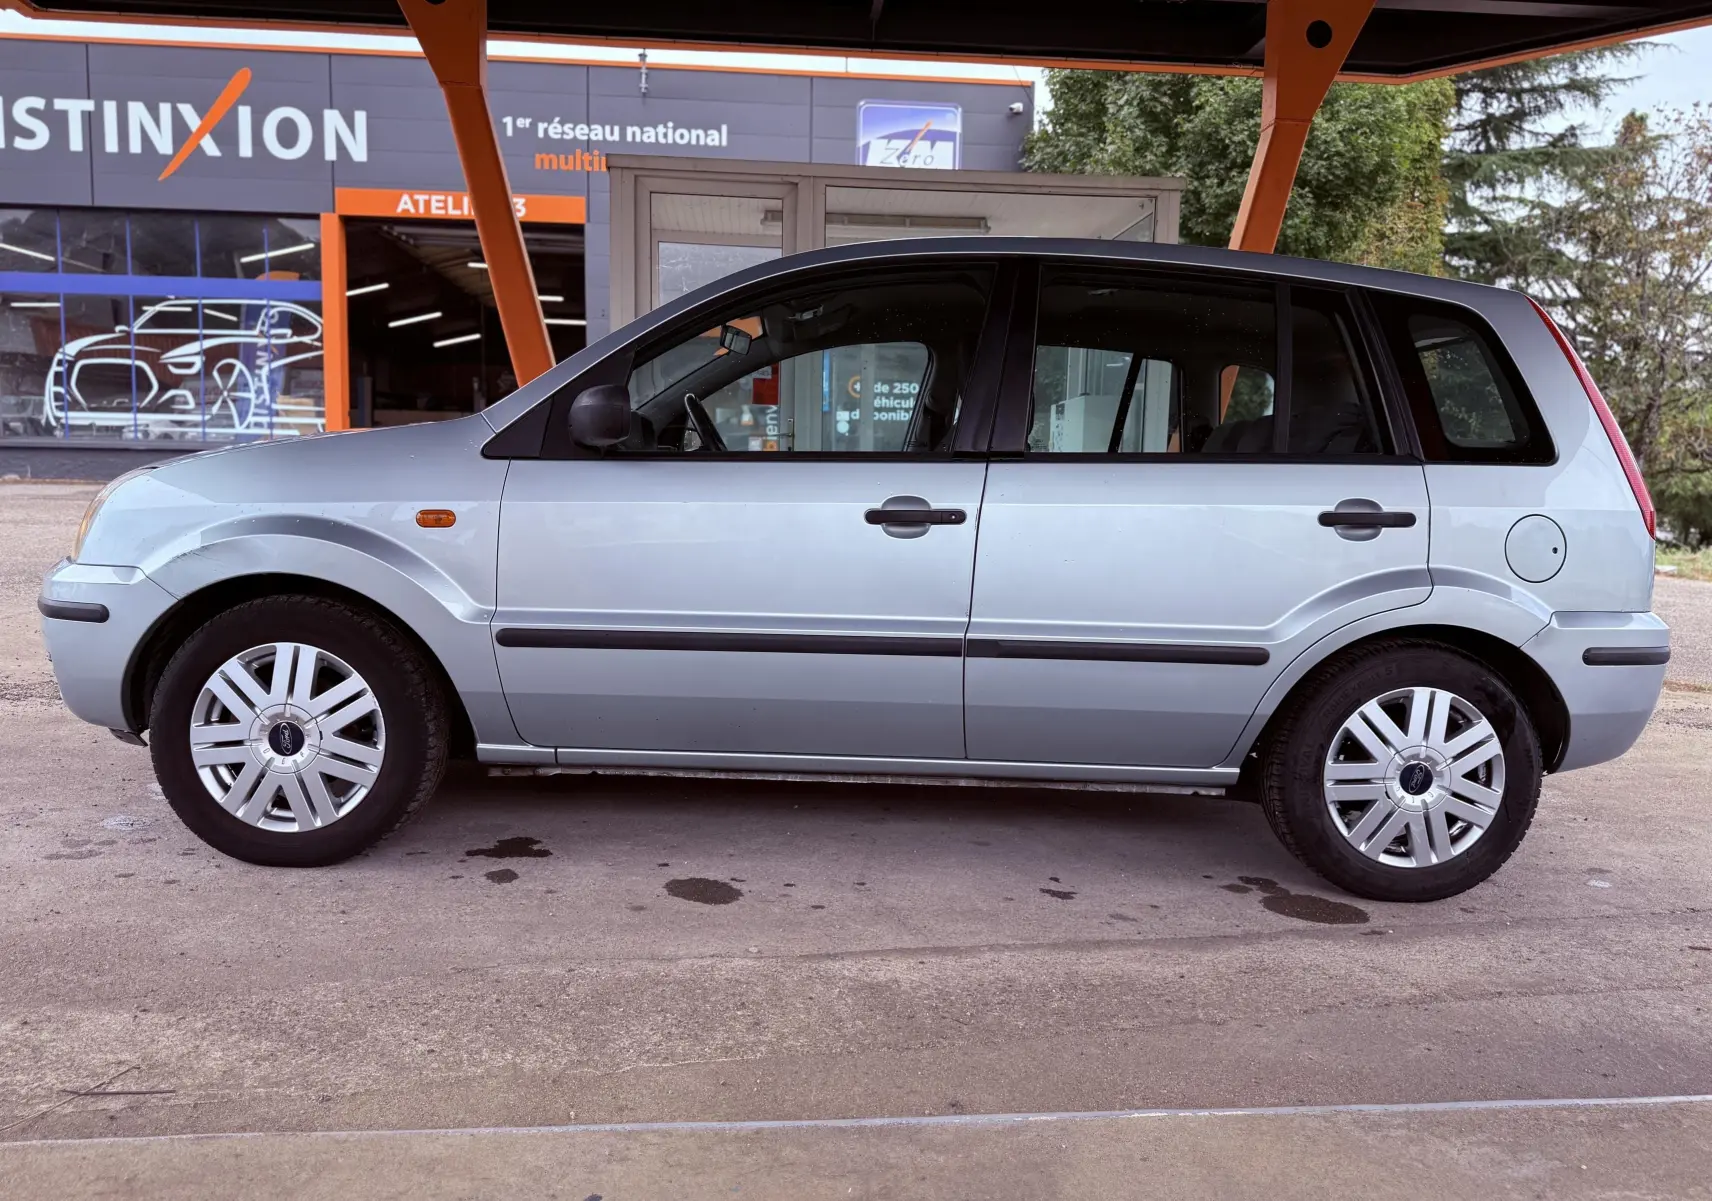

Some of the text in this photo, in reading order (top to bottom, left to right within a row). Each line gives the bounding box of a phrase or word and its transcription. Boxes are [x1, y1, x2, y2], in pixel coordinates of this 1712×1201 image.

[537, 117, 620, 142] réseau
[626, 121, 728, 147] national
[874, 382, 890, 393] de
[893, 382, 919, 394] 250
[873, 396, 916, 408] éhicul
